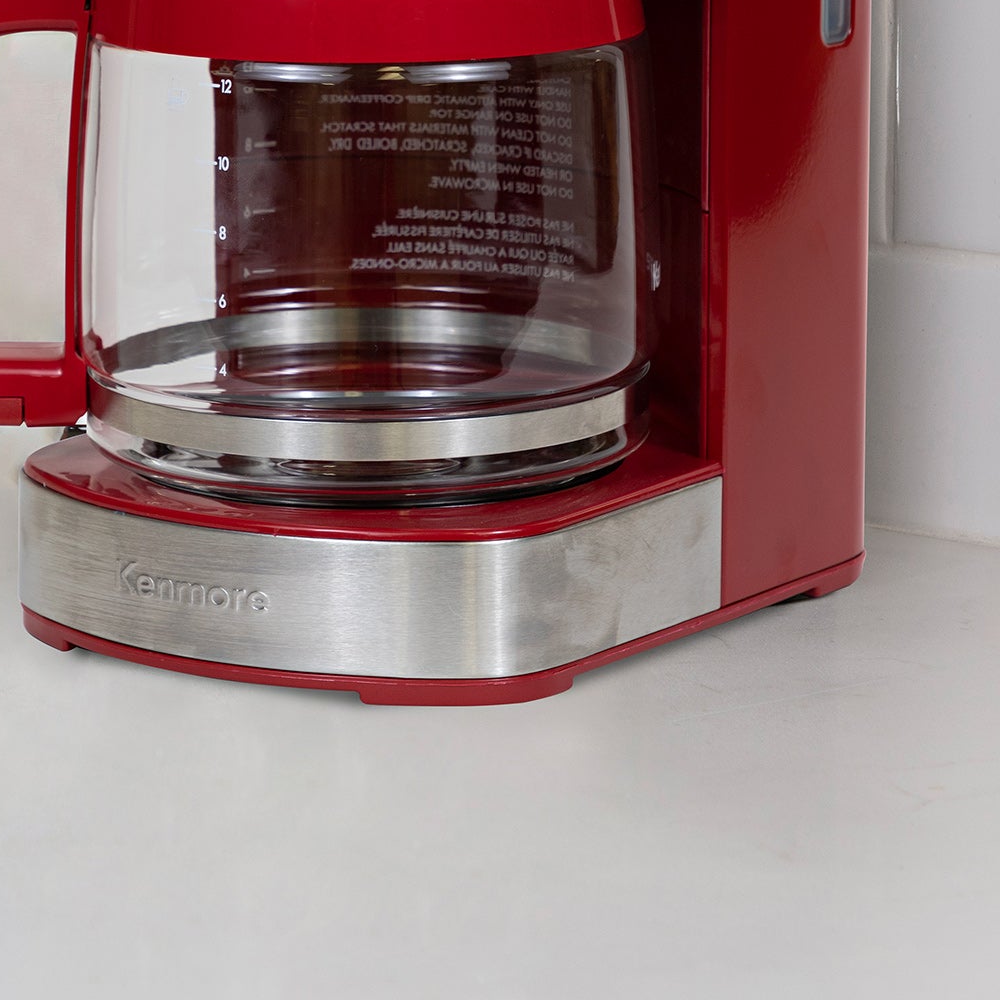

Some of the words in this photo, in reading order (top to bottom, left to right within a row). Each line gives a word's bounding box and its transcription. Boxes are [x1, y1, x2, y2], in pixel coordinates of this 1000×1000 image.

[220, 78, 232, 94] 12
[217, 156, 229, 171] 10
[218, 226, 228, 240] 8
[218, 294, 228, 308] 6
[218, 363, 228, 377] 4
[115, 558, 271, 612] Kenmore
